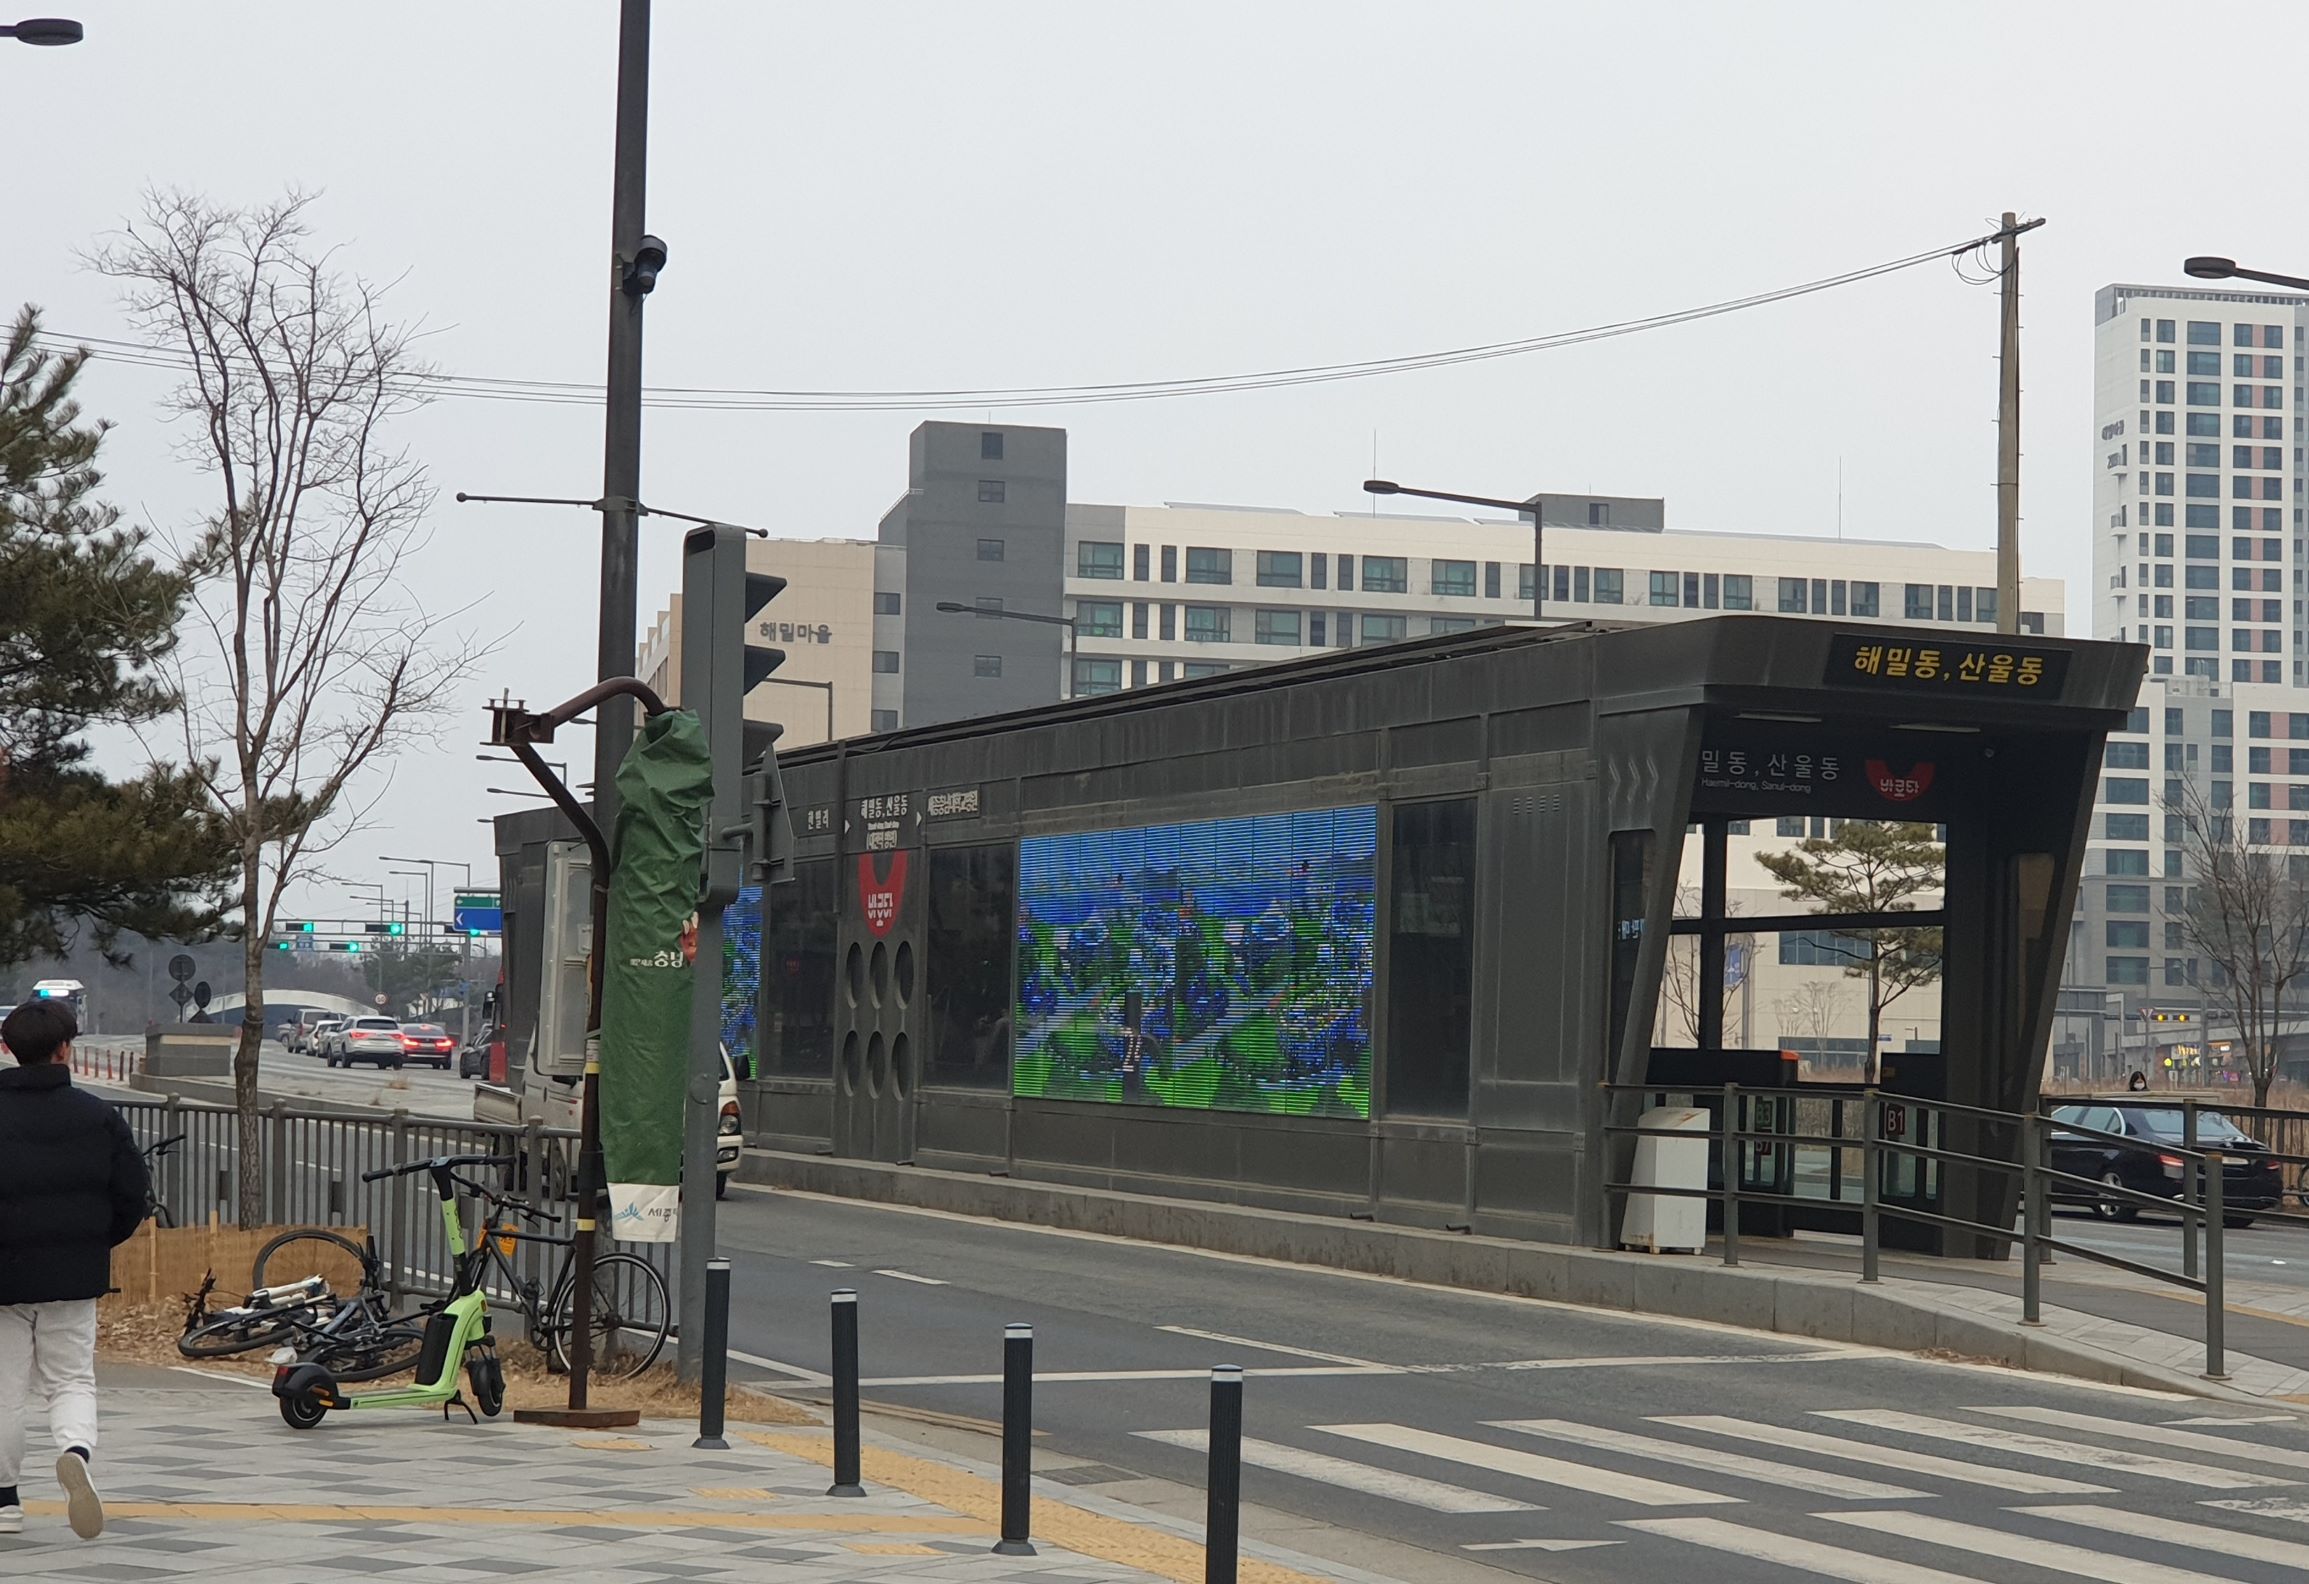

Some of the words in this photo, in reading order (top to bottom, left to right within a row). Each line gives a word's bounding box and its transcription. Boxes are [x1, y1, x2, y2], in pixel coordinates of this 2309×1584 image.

[760, 621, 832, 644] 해밀마을
[1854, 646, 1949, 682] 해밀동,
[1959, 652, 2043, 686] 산울동
[1702, 750, 1759, 777] 밀동,
[1767, 753, 1840, 781] 산울동
[1880, 778, 1919, 797] 바로타
[1887, 1109, 1904, 1131] B1
